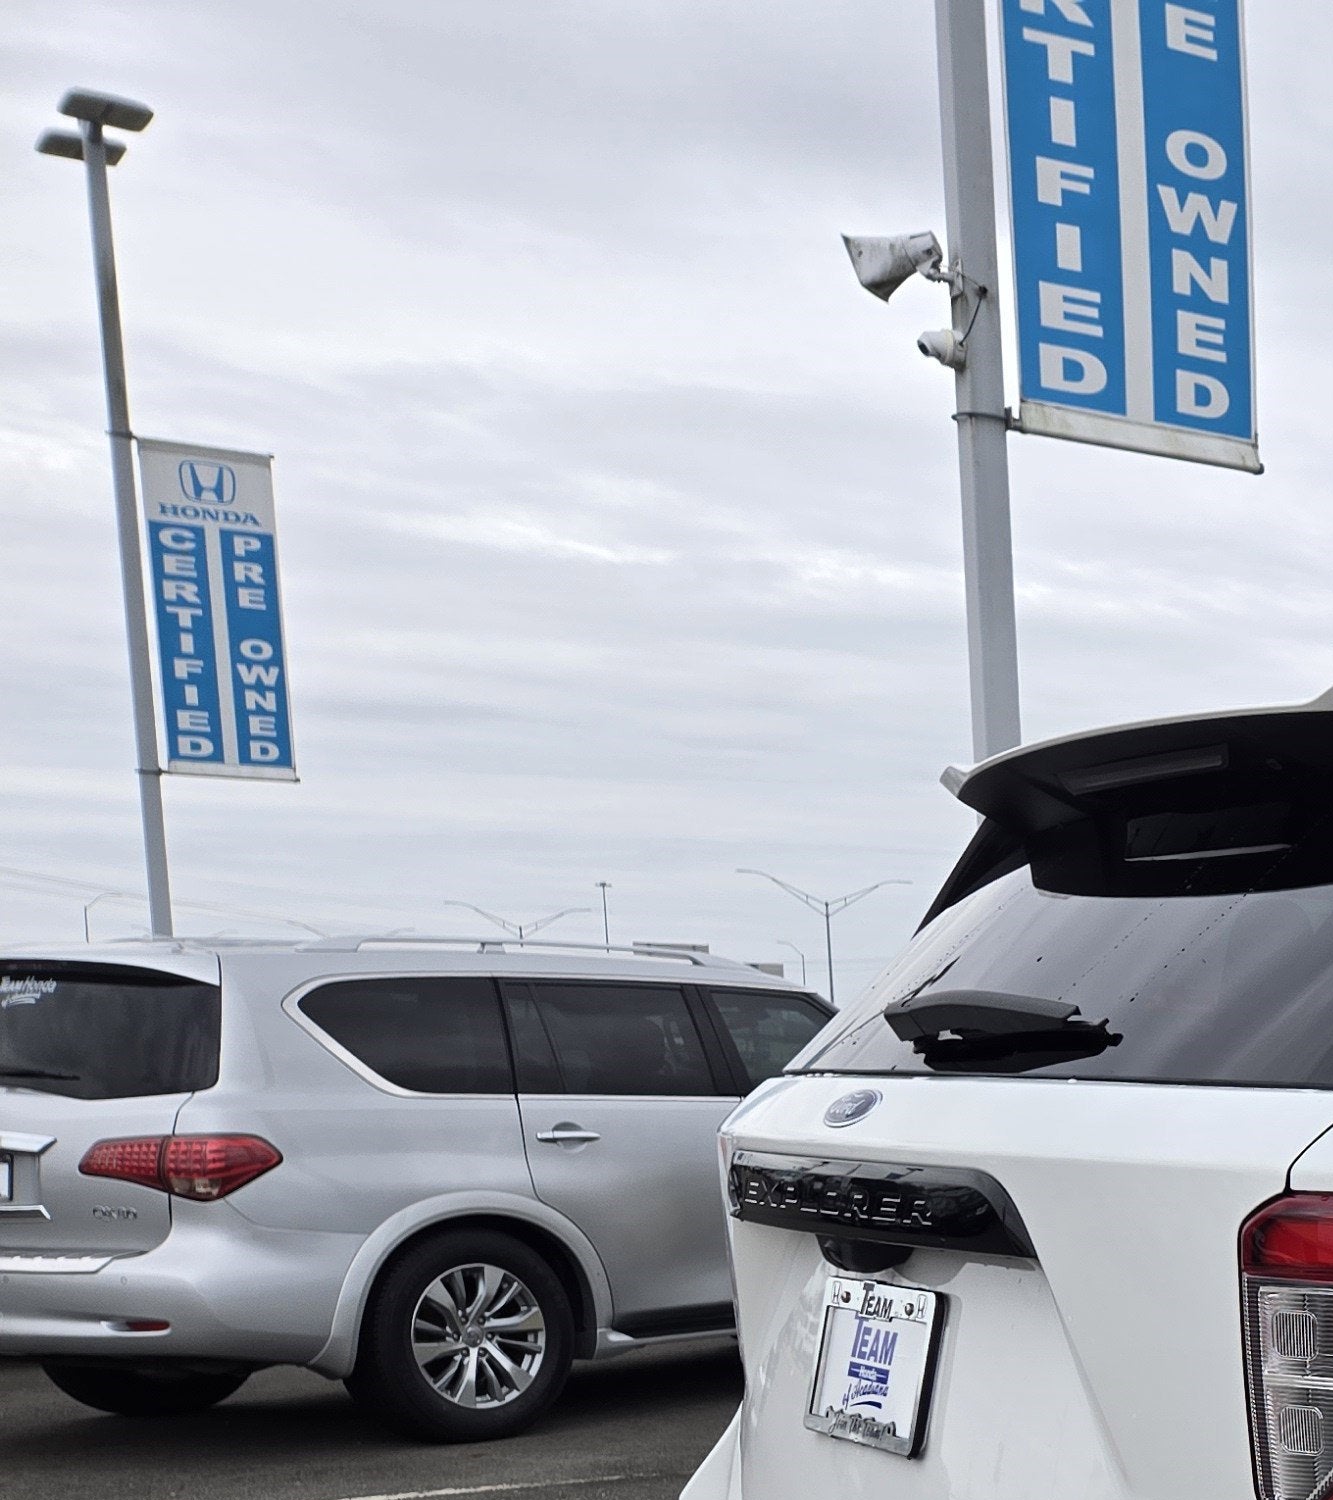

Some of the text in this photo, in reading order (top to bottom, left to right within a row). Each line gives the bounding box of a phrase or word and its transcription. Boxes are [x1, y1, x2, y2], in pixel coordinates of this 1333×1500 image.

[1156, 129, 1238, 420] OWNED
[157, 501, 263, 528] HONDA
[158, 526, 214, 759] CERTIFIED
[232, 535, 280, 763] PRE OWNED
[850, 1311, 899, 1367] TEAM
